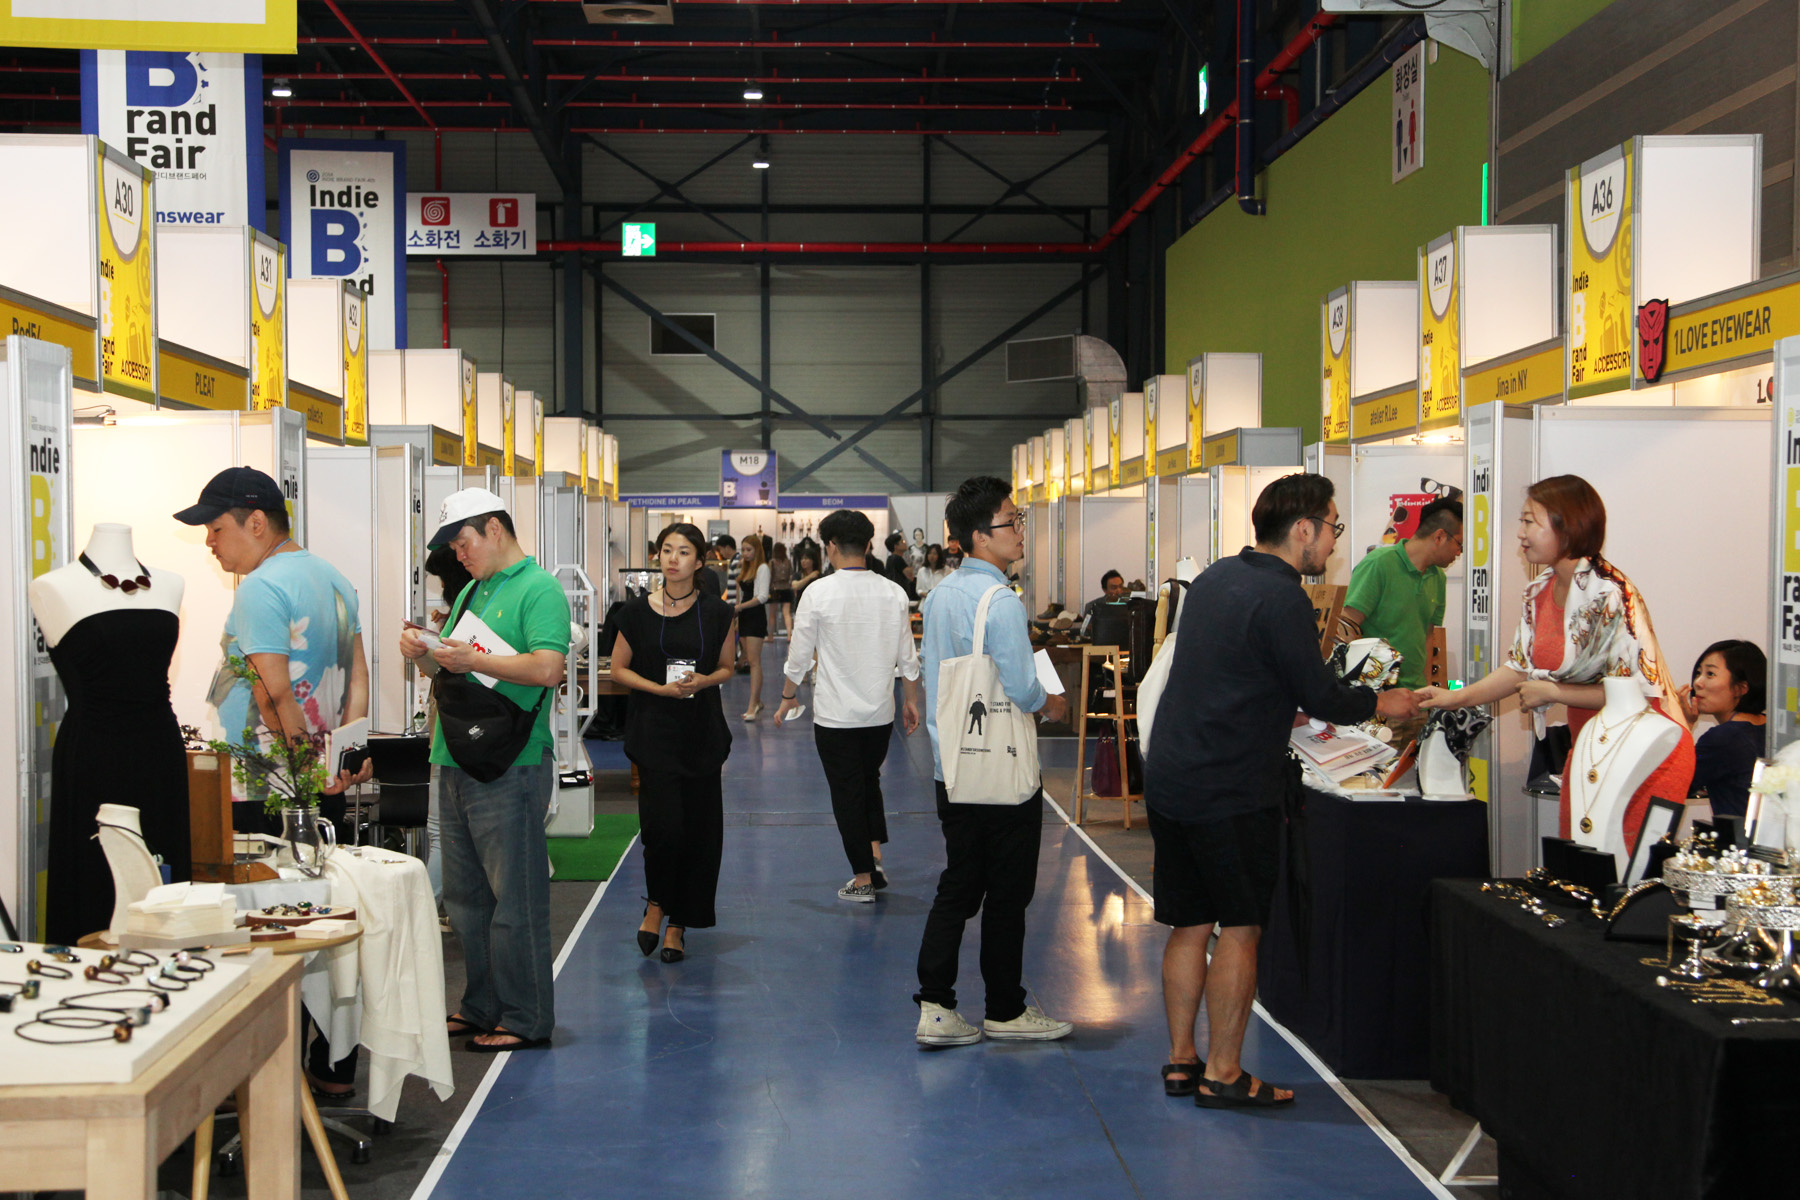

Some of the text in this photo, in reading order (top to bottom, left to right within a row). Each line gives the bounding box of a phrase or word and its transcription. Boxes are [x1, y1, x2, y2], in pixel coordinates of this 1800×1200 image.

[1395, 53, 1418, 93] 화장실
[126, 104, 216, 135] rand
[127, 137, 206, 169] Fair
[115, 178, 133, 217] A30
[310, 185, 379, 208] Indie
[1592, 176, 1613, 216] A36
[311, 209, 361, 276] B
[407, 230, 527, 249] 소화전 소화기
[260, 255, 272, 284] A31
[1434, 256, 1447, 286] A37
[1573, 271, 1589, 293] Indie
[1333, 305, 1343, 330] A38
[1573, 292, 1586, 349] B
[1674, 305, 1771, 355] 1LOVE EYEWEAR
[1572, 343, 1587, 364] rand
[1593, 350, 1630, 375] ACCESSORY
[121, 359, 151, 383] ACCESSORY
[1423, 345, 1432, 390] B
[1572, 363, 1585, 384] Fair
[195, 372, 215, 398] PLEAT
[1496, 368, 1528, 398] Jina in NY
[1370, 404, 1398, 426] atelier R.Lee
[740, 456, 759, 465] M18
[667, 497, 677, 506] IN
[677, 497, 702, 505] PEARL
[723, 481, 736, 497] B
[822, 498, 843, 506] BEOM
[1473, 494, 1489, 567] B
[1472, 589, 1488, 614] Fair
